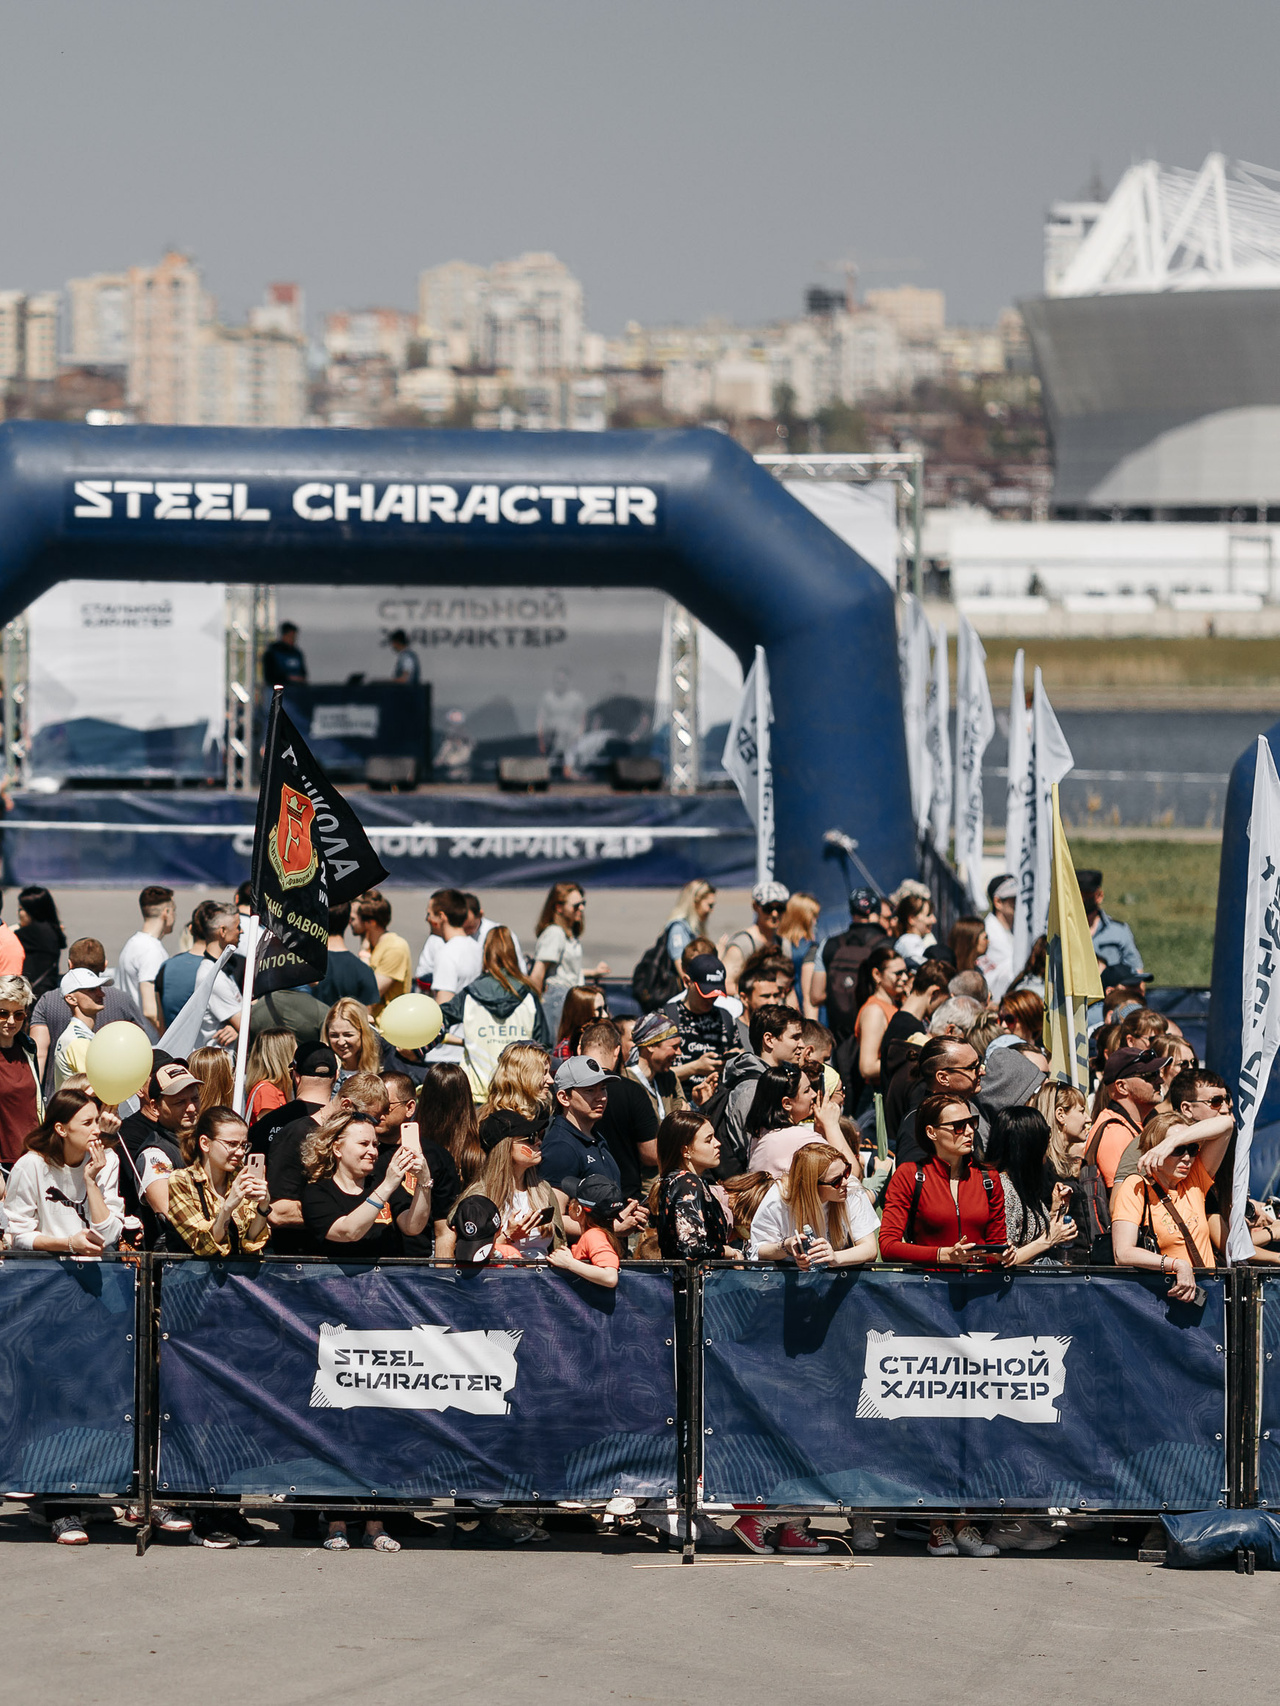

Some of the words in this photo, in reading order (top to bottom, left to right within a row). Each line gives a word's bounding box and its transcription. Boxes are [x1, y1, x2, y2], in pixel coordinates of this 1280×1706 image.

[74, 480, 271, 521] STEEL
[292, 482, 658, 526] CHARACTER
[378, 590, 567, 620] СТАЛЬНОЙ
[477, 1025, 529, 1038] СТЕПЬ
[334, 1348, 425, 1367] STEEL
[879, 1350, 1050, 1377] СТАЛЬНОЙ
[335, 1371, 503, 1393] CHARACTER
[880, 1380, 1050, 1401] ХАРАКТЕР
